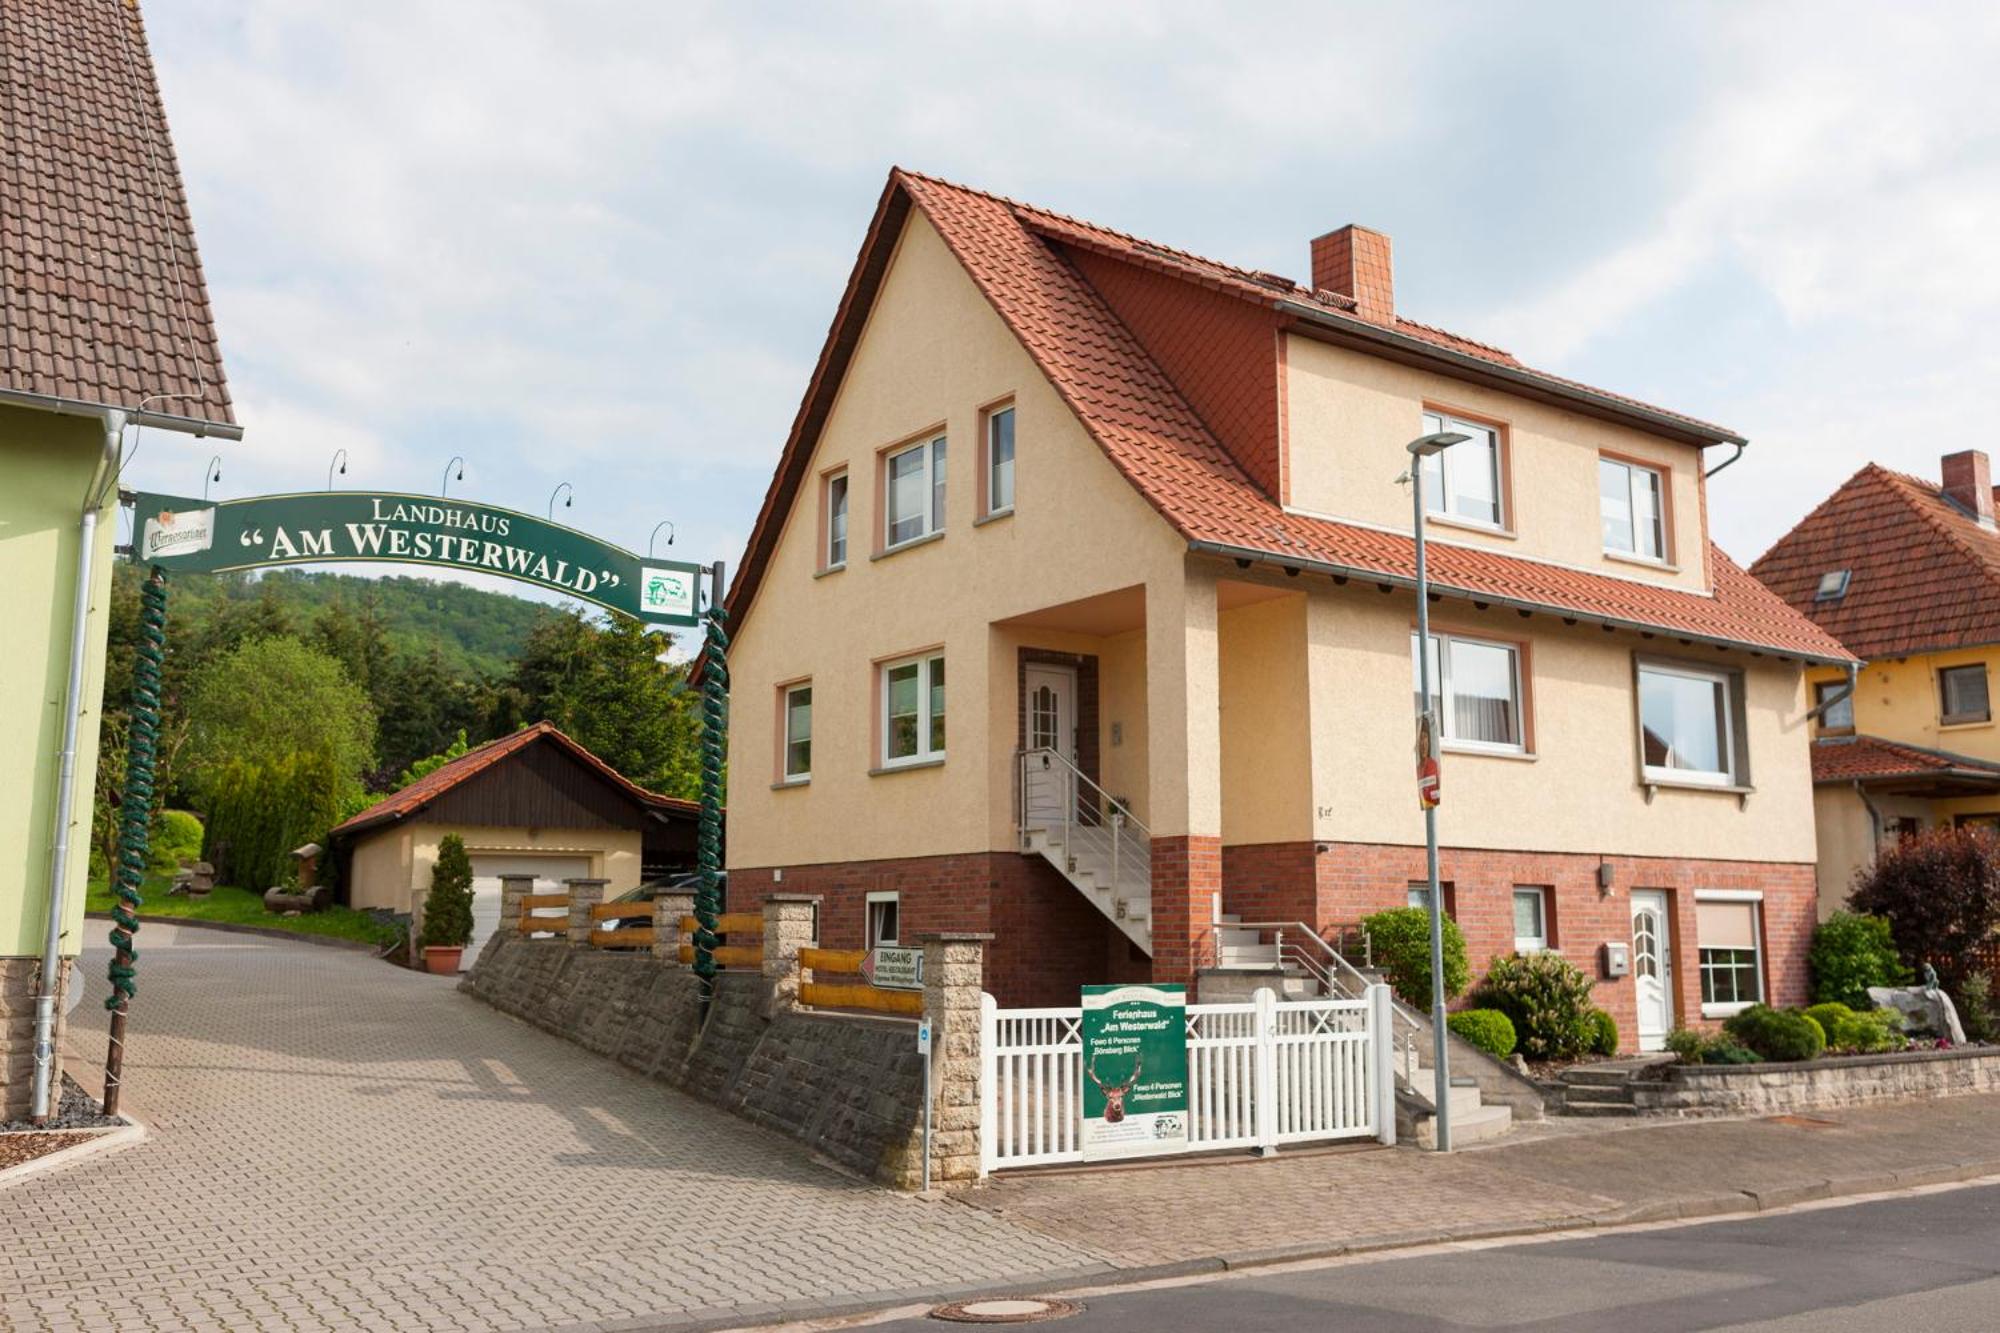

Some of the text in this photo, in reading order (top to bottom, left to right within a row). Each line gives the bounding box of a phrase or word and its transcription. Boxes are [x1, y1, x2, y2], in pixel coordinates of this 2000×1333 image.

[372, 498, 511, 537] LANDHAUS
[880, 951, 912, 964] EINGANG
[1112, 1009, 1157, 1019] Ferienhaus
[1113, 1036, 1141, 1045] Personen
[1155, 1081, 1182, 1091] Personen
